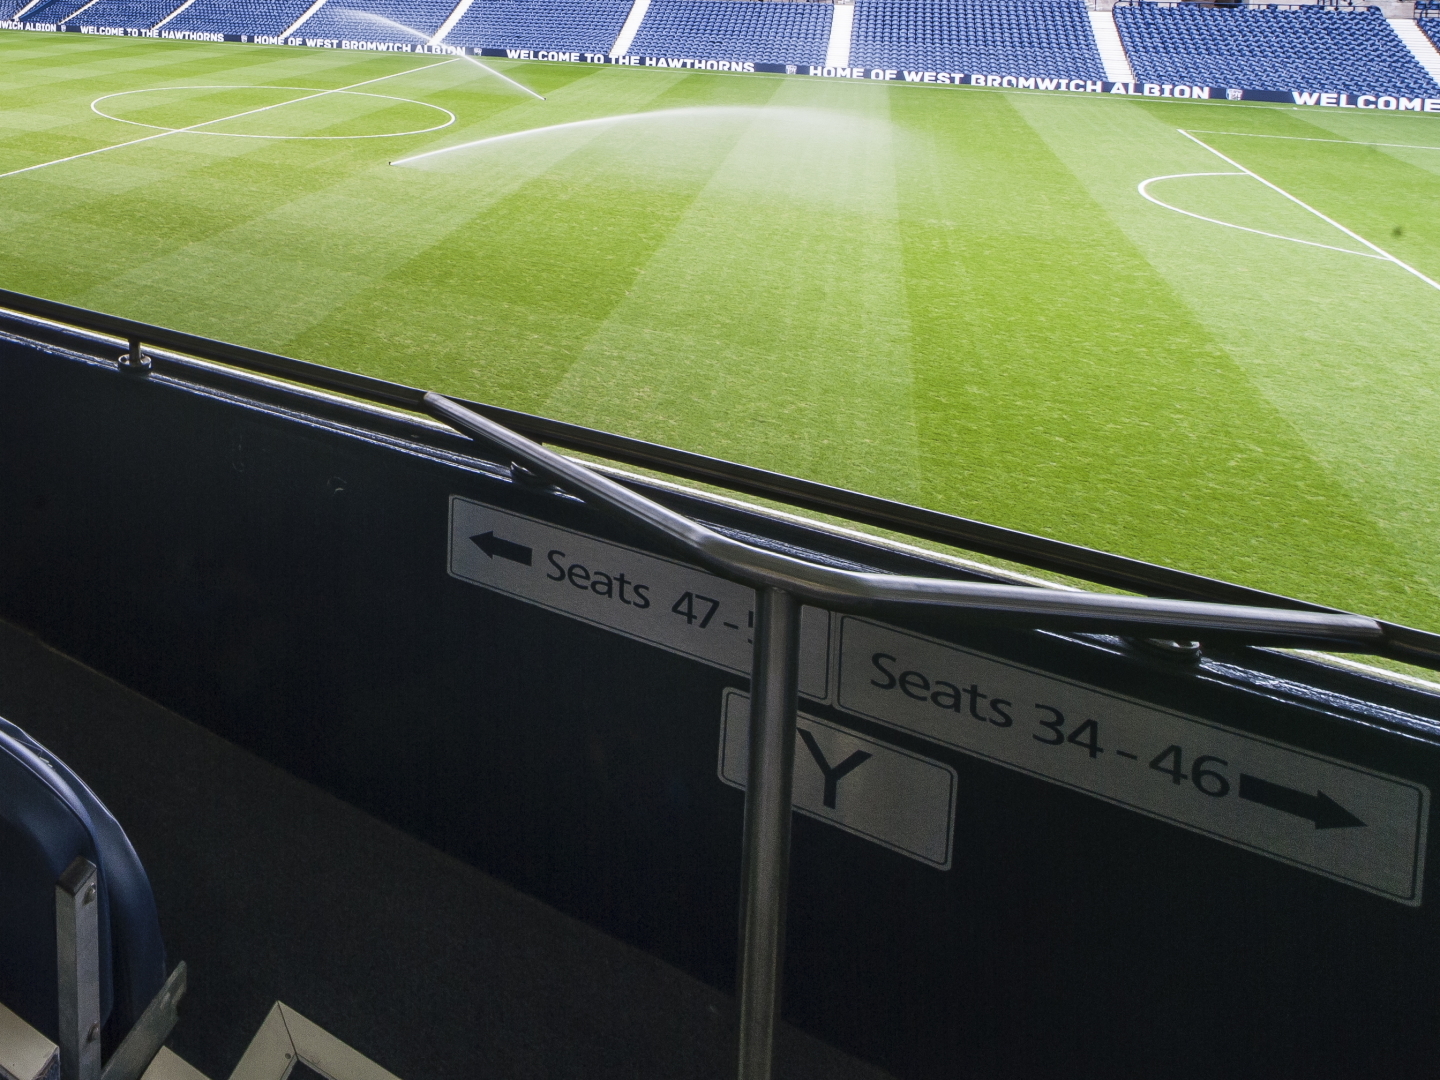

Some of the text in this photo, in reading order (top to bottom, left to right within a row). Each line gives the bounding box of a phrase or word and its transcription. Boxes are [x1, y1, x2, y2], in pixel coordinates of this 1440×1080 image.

[25, 22, 56, 32] ALBION
[80, 25, 224, 42] WELCOME TO THE HAWTHORNS
[254, 35, 284, 46] HOME
[288, 37, 303, 46] OF
[341, 39, 411, 53] BROMWICH
[414, 44, 465, 56] ALBION
[506, 49, 755, 73] WELCOME TO THE HAWTHORNS
[809, 65, 1210, 100] HOME OF WEST BROMWICH ALBION
[1292, 91, 1440, 113] WELCOME
[547, 549, 650, 609] Seats
[870, 653, 1013, 728] Seats
[796, 727, 873, 810] Y
